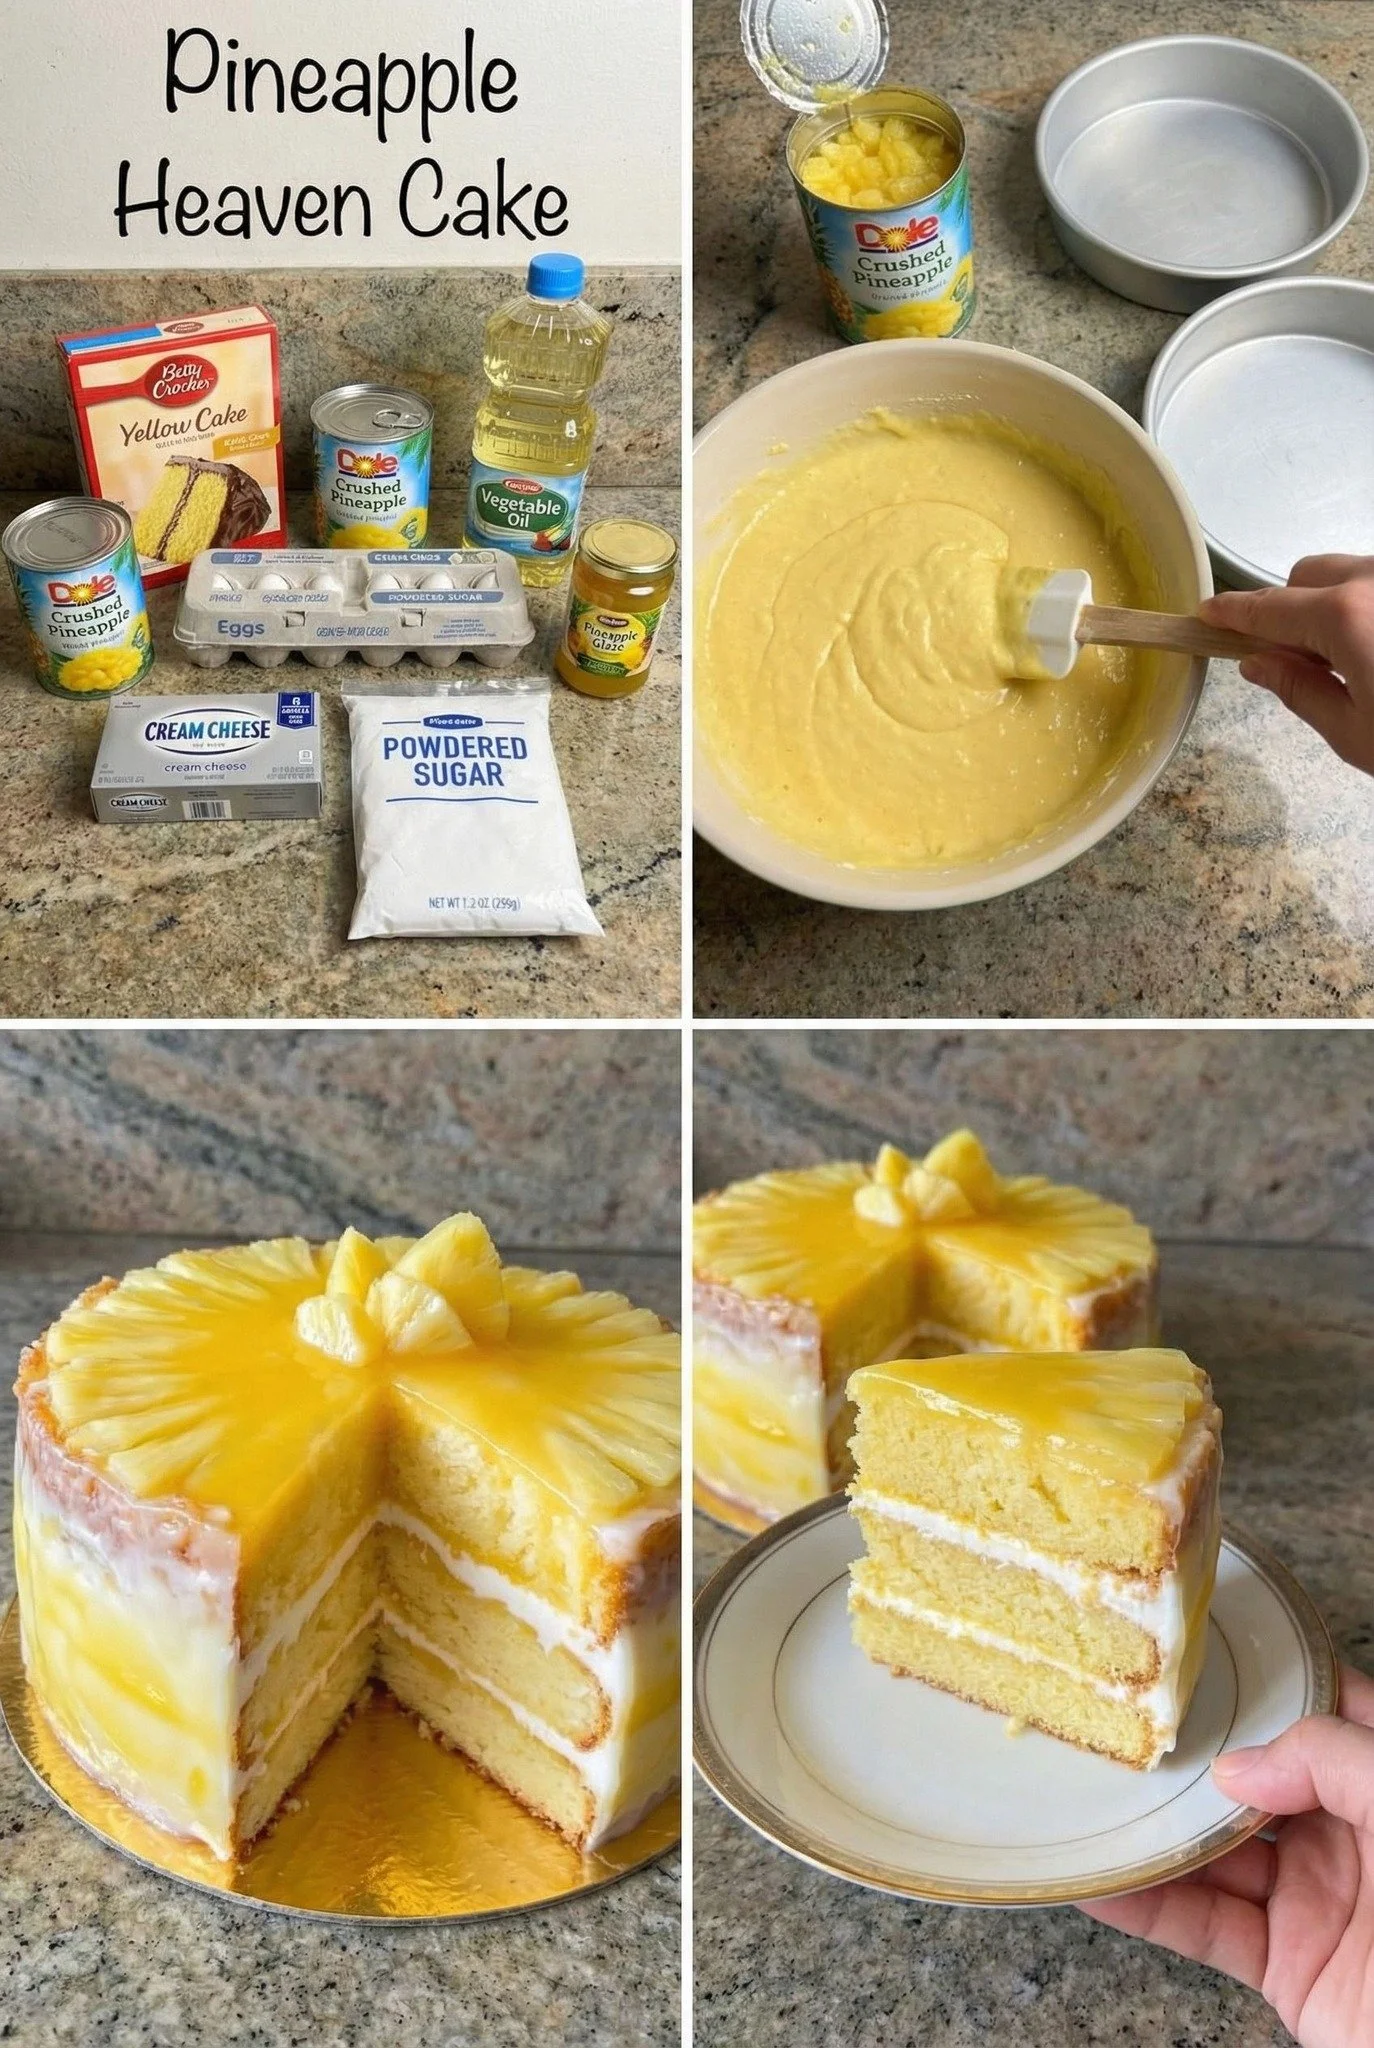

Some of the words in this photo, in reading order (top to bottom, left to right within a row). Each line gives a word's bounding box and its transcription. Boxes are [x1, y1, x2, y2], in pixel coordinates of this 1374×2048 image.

[854, 215, 939, 250] Dole
[857, 240, 946, 272] Crushed
[852, 256, 953, 289] Pineapple
[162, 363, 203, 382] Betty
[152, 374, 210, 399] Crocker
[119, 418, 192, 447] Yellow
[195, 404, 248, 432] Cake
[336, 448, 399, 479] Dole
[335, 477, 402, 496] Crushed
[330, 489, 407, 514] Pineapple
[481, 487, 561, 516] Vegetable
[507, 513, 530, 528] Oil
[48, 574, 117, 606] Dole
[51, 595, 123, 624] Crushed
[47, 608, 130, 640] Pineapple
[217, 619, 265, 638] Eggs
[144, 721, 204, 742] CREAM
[206, 720, 271, 740] CHEESE
[383, 735, 528, 760] POWDERED
[164, 763, 202, 773] cream
[414, 761, 505, 787] SUGAR
[429, 897, 445, 909] NET
[447, 897, 460, 909] WT
